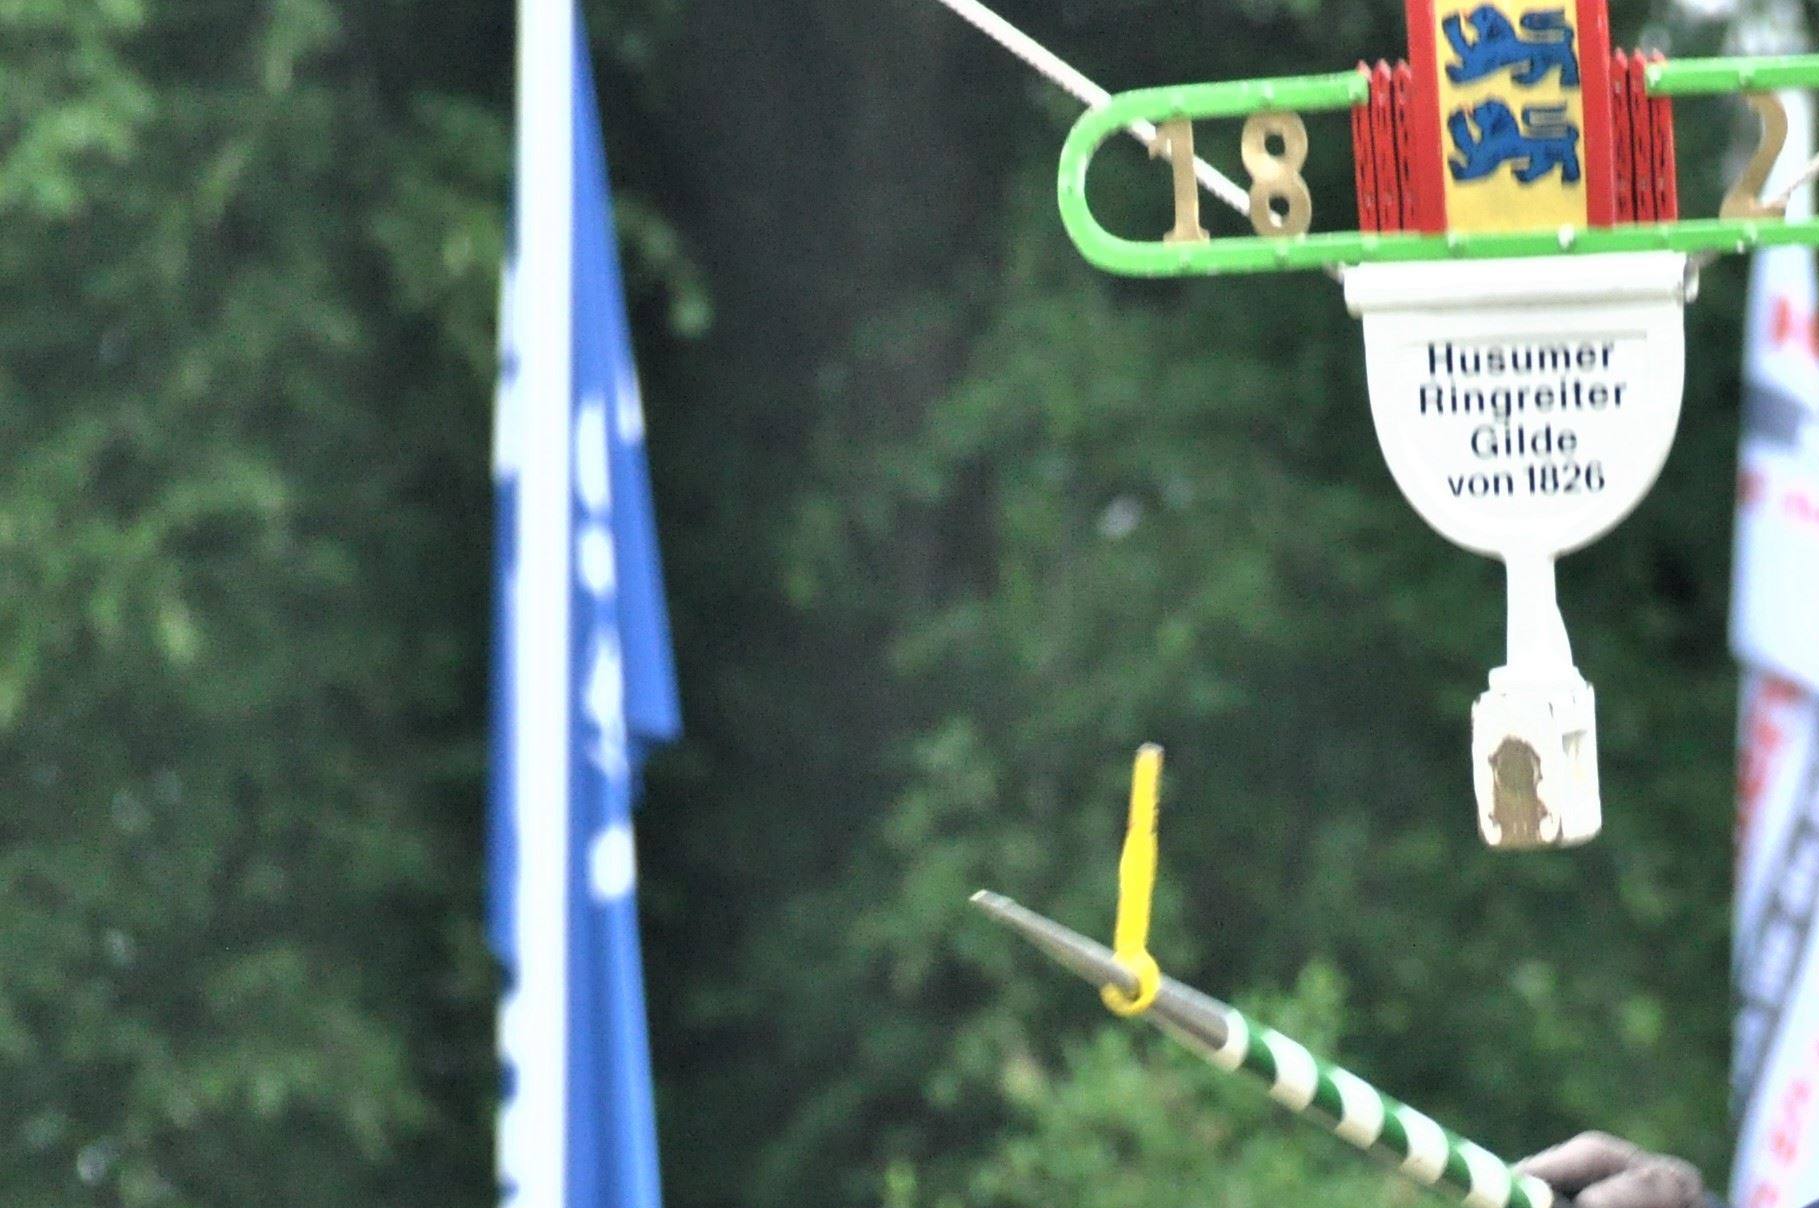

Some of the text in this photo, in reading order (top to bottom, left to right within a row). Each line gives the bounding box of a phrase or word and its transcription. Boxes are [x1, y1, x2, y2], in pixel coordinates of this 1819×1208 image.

[1427, 341, 1615, 376] Husumer
[1419, 378, 1627, 423] Ringreiter
[1470, 421, 1578, 459] Gilde
[1447, 459, 1606, 497] von 1826
